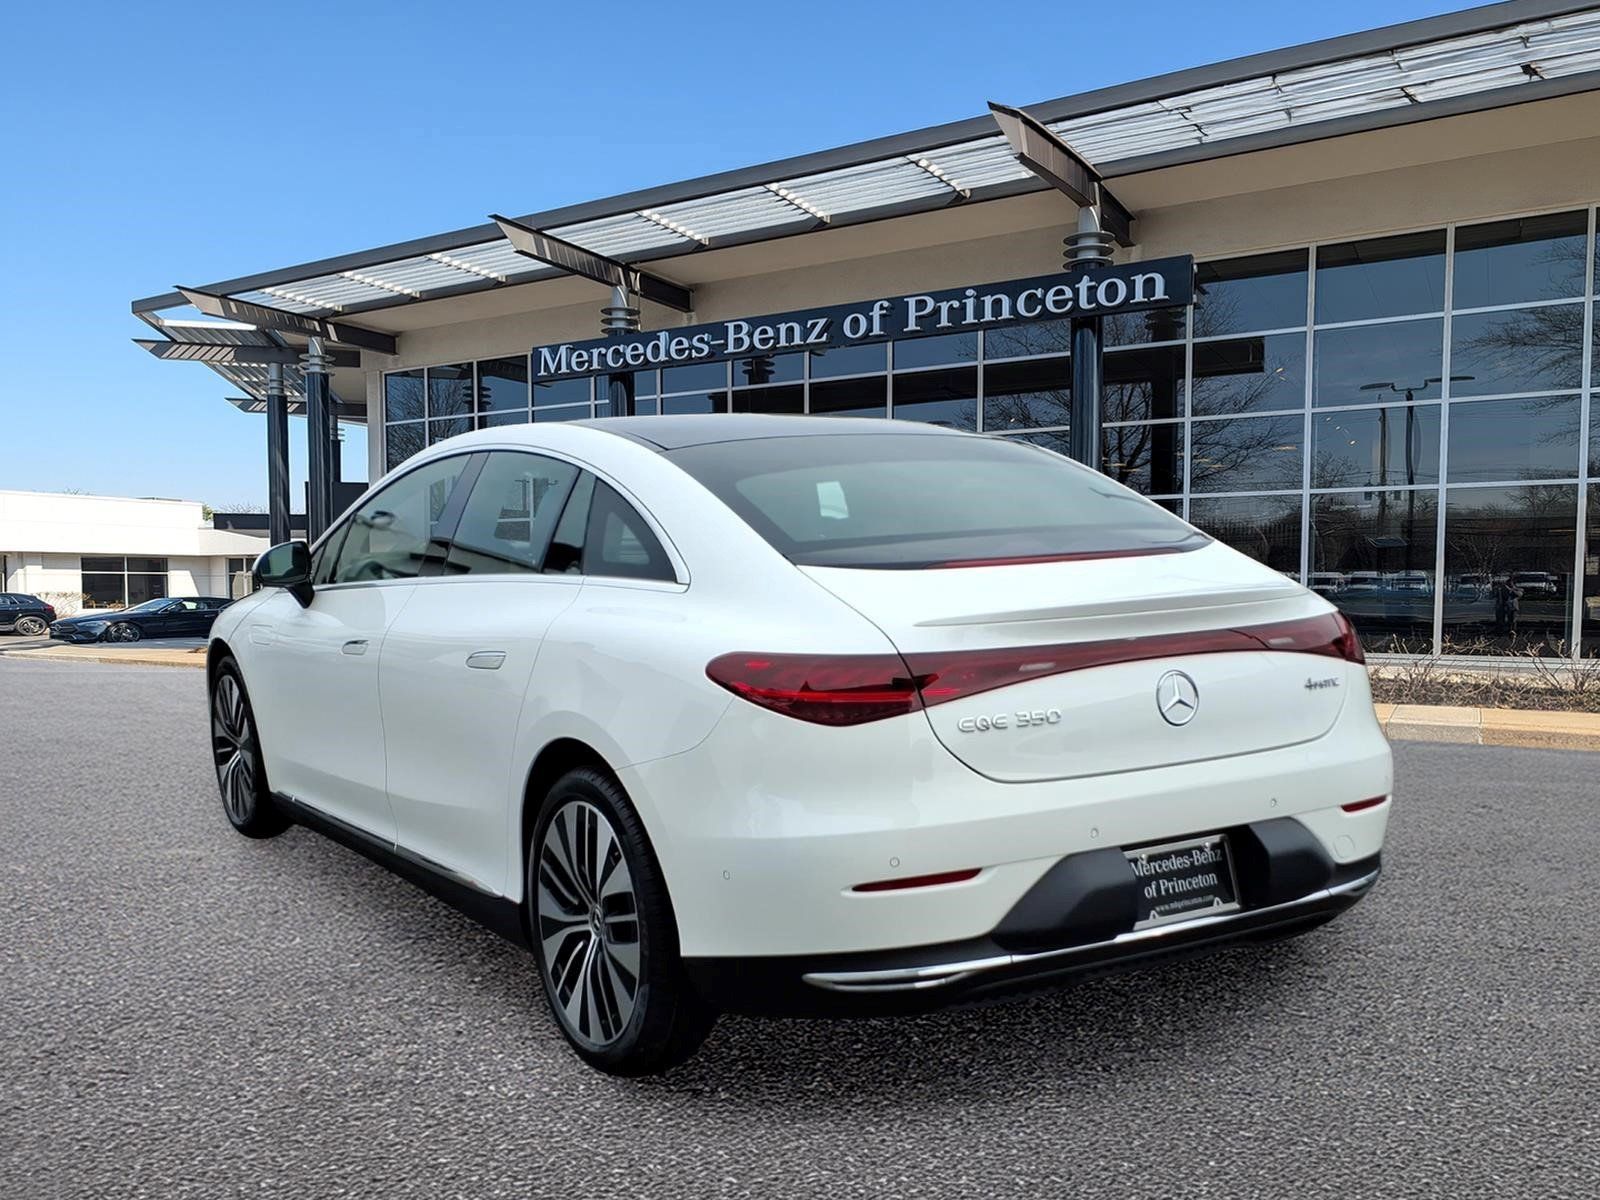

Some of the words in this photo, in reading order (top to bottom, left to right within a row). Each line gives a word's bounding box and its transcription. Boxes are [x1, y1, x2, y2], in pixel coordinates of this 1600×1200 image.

[537, 316, 830, 377] Mercedes-Benz
[842, 300, 890, 339] of
[903, 271, 1169, 332] Princeton
[958, 714, 1008, 733] EQE
[1015, 708, 1062, 728] 350
[1130, 849, 1222, 876] Mercedes-Benz
[1144, 881, 1158, 899] of
[1160, 873, 1218, 896] Princeton
